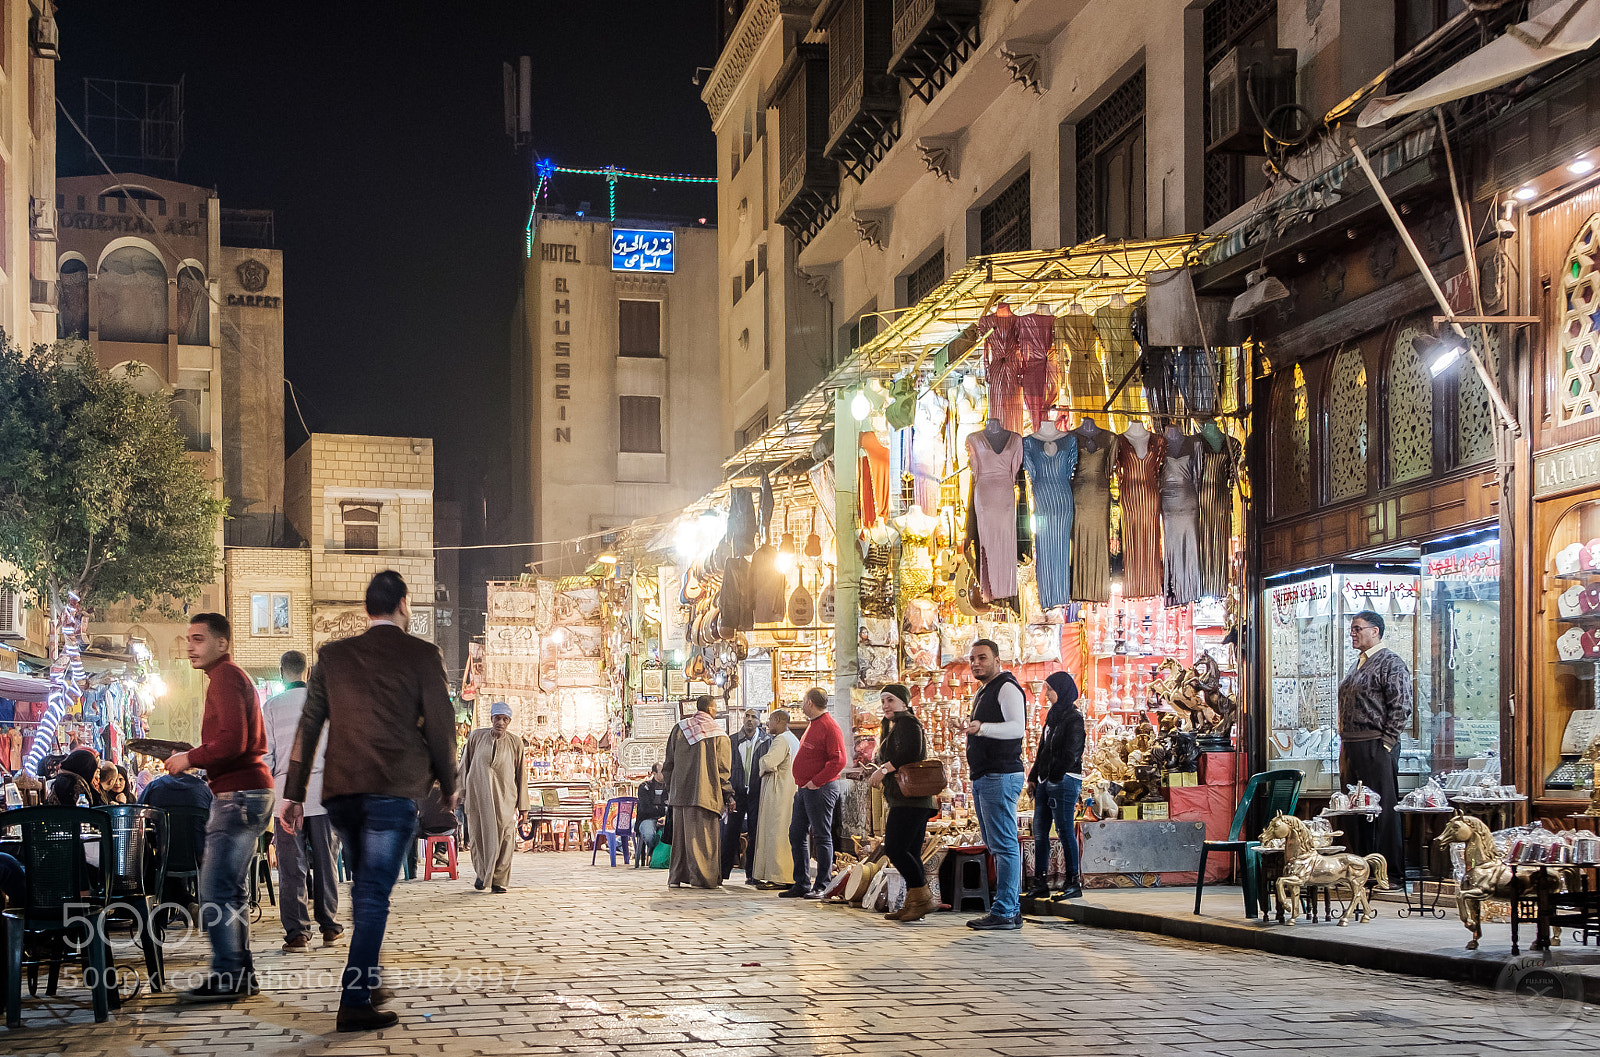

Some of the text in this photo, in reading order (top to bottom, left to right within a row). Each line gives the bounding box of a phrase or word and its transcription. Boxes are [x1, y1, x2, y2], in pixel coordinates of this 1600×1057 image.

[164, 218, 202, 236] ART
[541, 243, 581, 263] HOTEL
[613, 234, 672, 256] فندق الحسين
[227, 294, 281, 308] CARPET
[555, 278, 571, 443] EL HUSSEIN
